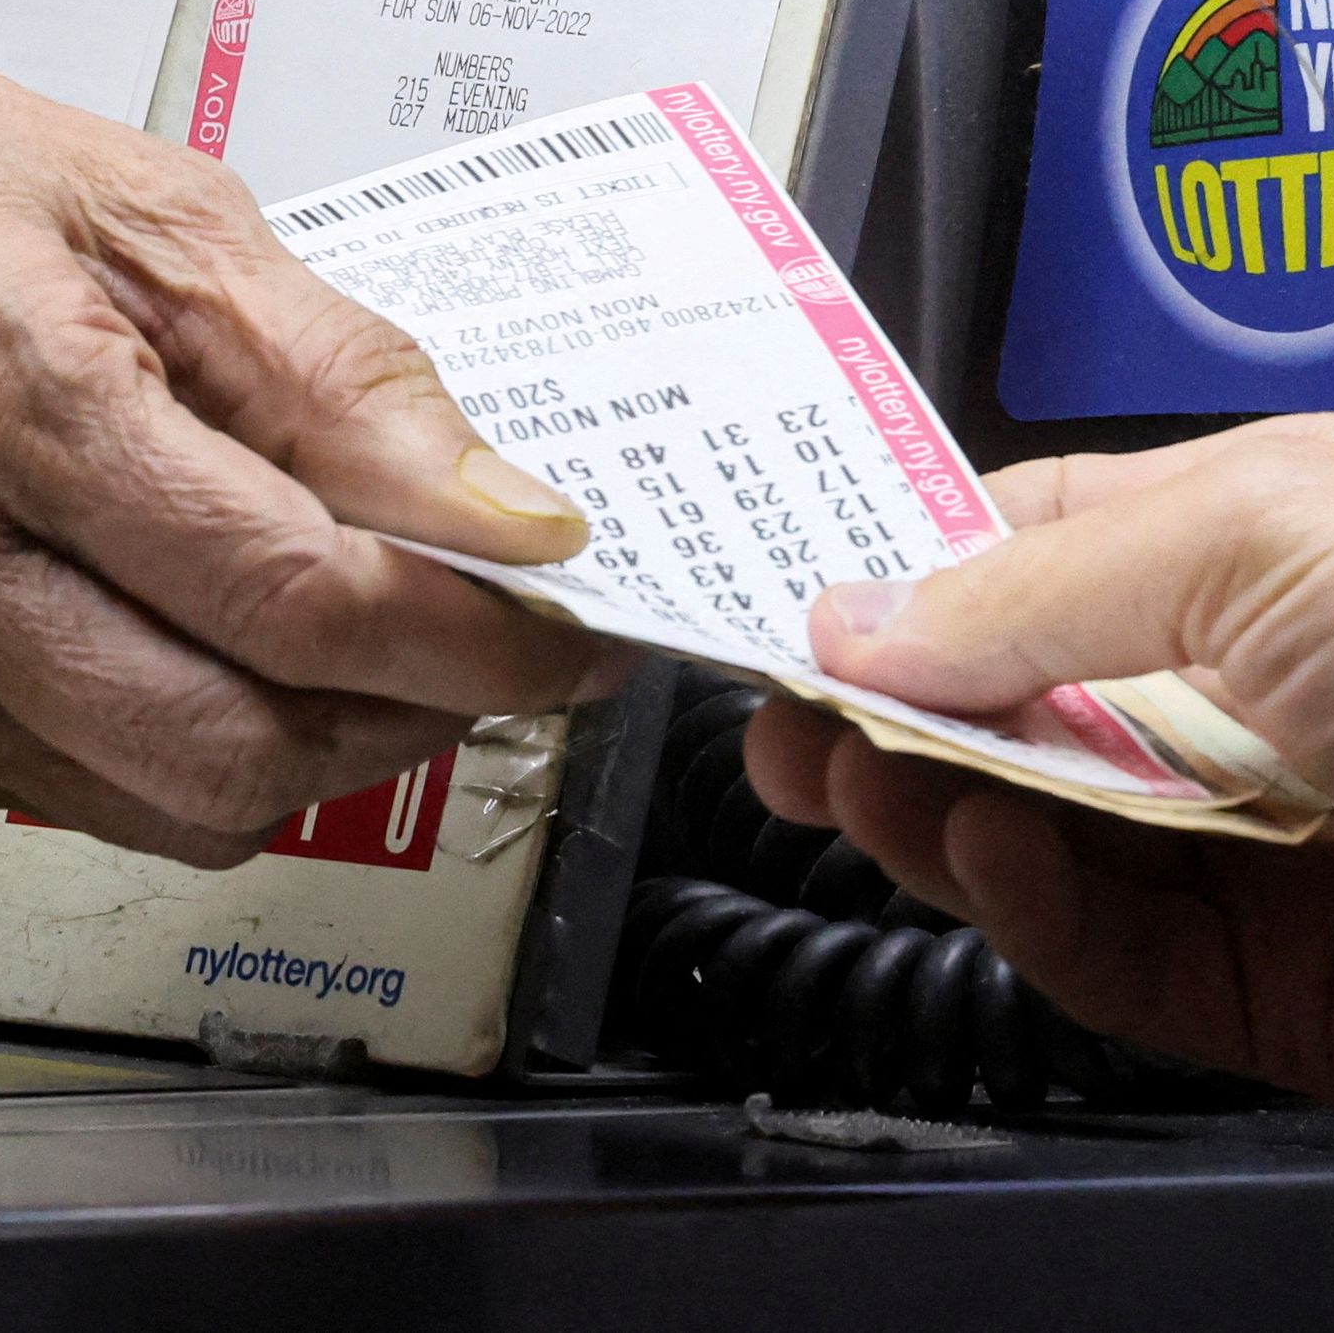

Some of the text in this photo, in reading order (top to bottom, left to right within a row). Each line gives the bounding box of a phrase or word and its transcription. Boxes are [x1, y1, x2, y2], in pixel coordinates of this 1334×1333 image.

[469, 2, 591, 36] 06-NOV-2022
[434, 51, 513, 83] NUMBERS
[394, 76, 529, 113] 215 EVENING
[389, 102, 514, 135] 027 MIDDAY
[664, 90, 800, 249] nylottery.ny.gov
[535, 192, 565, 208] IS
[577, 174, 659, 200] TICKET
[415, 199, 527, 234] REQUIRED
[375, 230, 405, 244] TO
[528, 262, 643, 294] GAMBLING
[590, 294, 660, 319] MON
[457, 325, 487, 346] 22
[497, 309, 583, 338] NOV07
[461, 378, 564, 417] $20.00
[494, 383, 692, 445] MON NOV07
[837, 336, 973, 519] nylottery.ny.gov
[545, 404, 828, 485] 23 31 48 51
[583, 435, 843, 511] 10 14 15 6
[818, 464, 861, 493] 17
[734, 482, 783, 511] 29
[831, 493, 879, 520] 12
[658, 501, 705, 529] 61
[751, 511, 801, 540] 23
[673, 530, 723, 558] 36
[848, 521, 894, 549] 19
[595, 547, 639, 569] 49
[768, 539, 818, 569] 26
[865, 550, 913, 578] 10
[689, 562, 735, 588] 43
[185, 942, 406, 1007] nylottery.org
